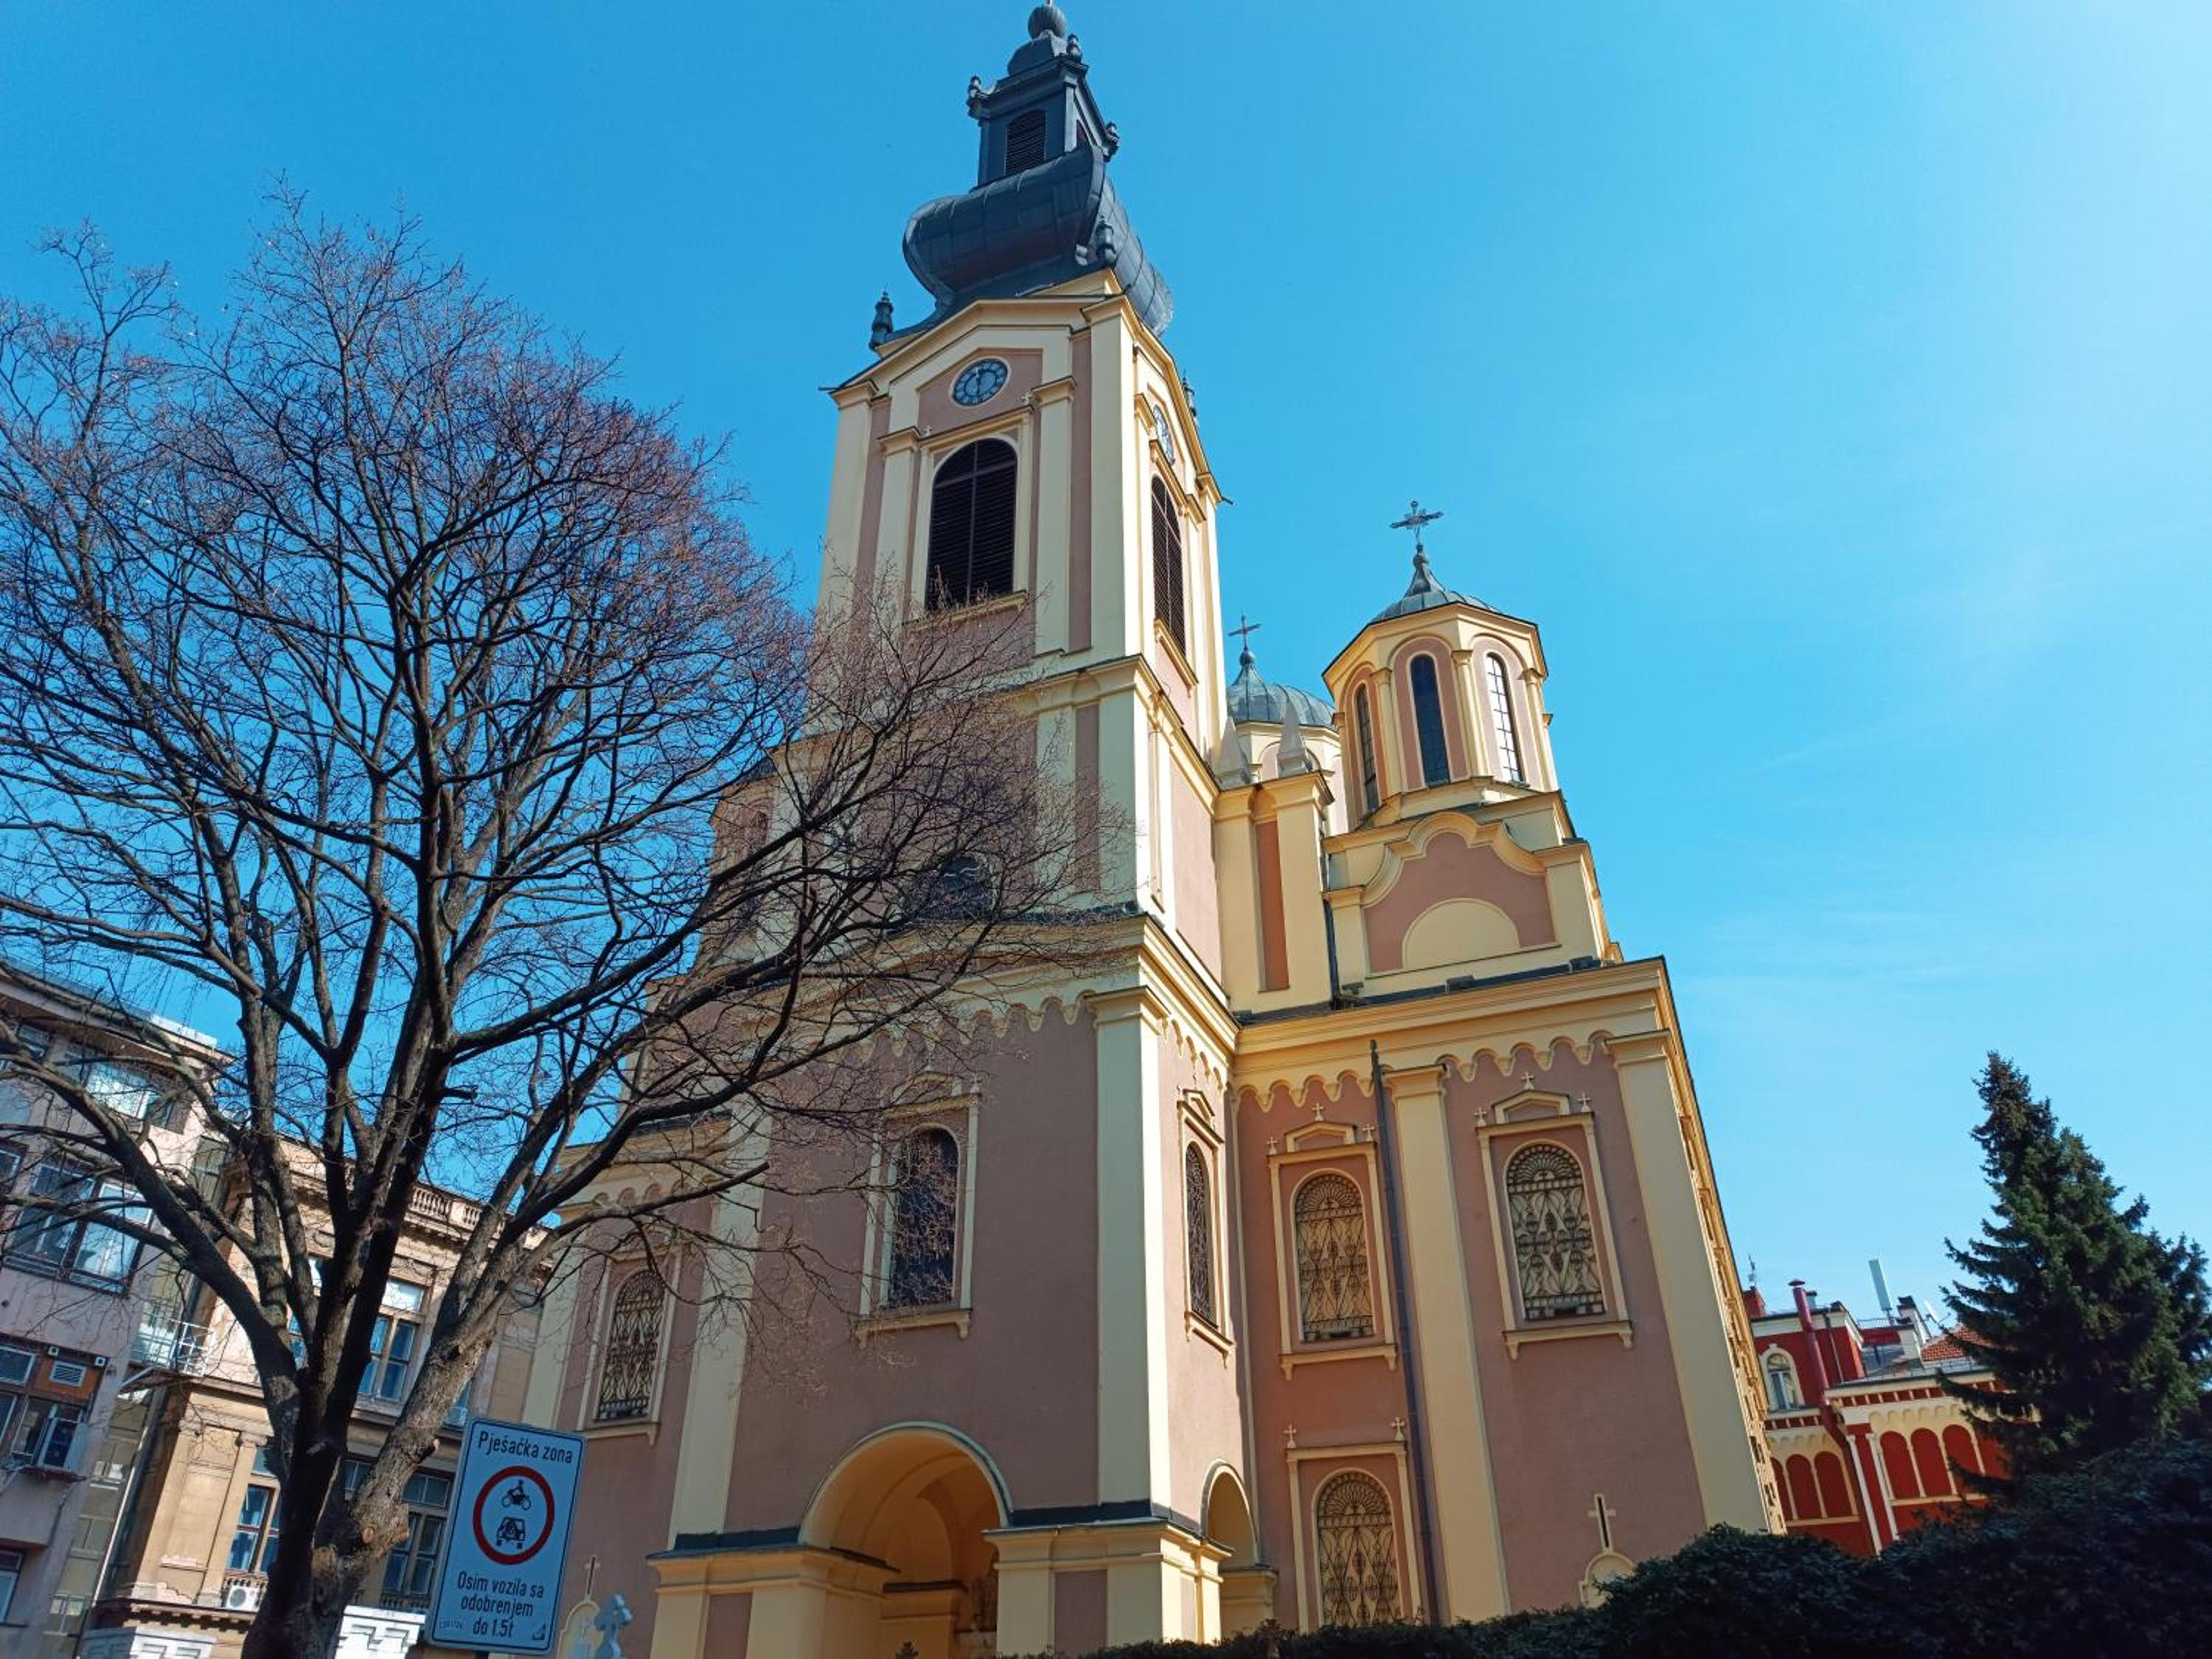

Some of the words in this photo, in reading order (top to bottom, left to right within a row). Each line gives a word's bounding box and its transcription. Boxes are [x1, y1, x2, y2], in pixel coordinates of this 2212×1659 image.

[543, 1446, 573, 1464] zona
[457, 1571, 488, 1591] Osim
[492, 1578, 527, 1596] vozila
[530, 1584, 544, 1599] sa
[461, 1593, 533, 1619] odobrenjem
[473, 1617, 488, 1635] do
